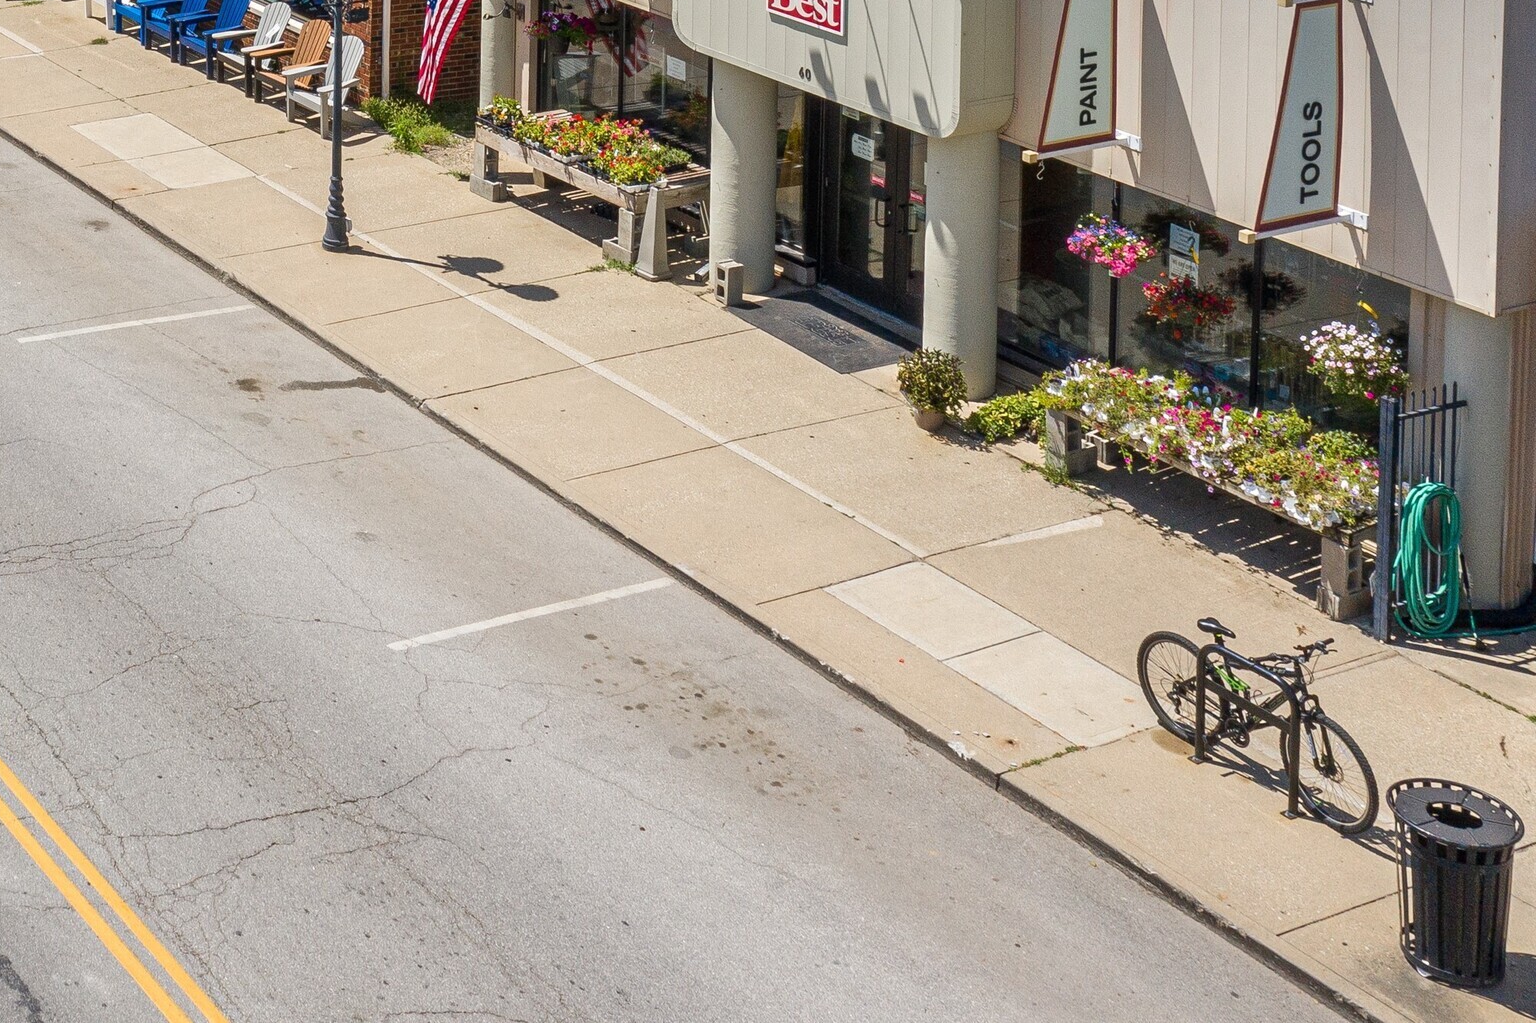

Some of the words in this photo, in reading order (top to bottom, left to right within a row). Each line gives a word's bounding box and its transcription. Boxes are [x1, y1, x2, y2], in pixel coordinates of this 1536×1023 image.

[798, 66, 812, 82] 60
[1079, 48, 1097, 126] PAINT
[1300, 101, 1322, 204] TOOLS
